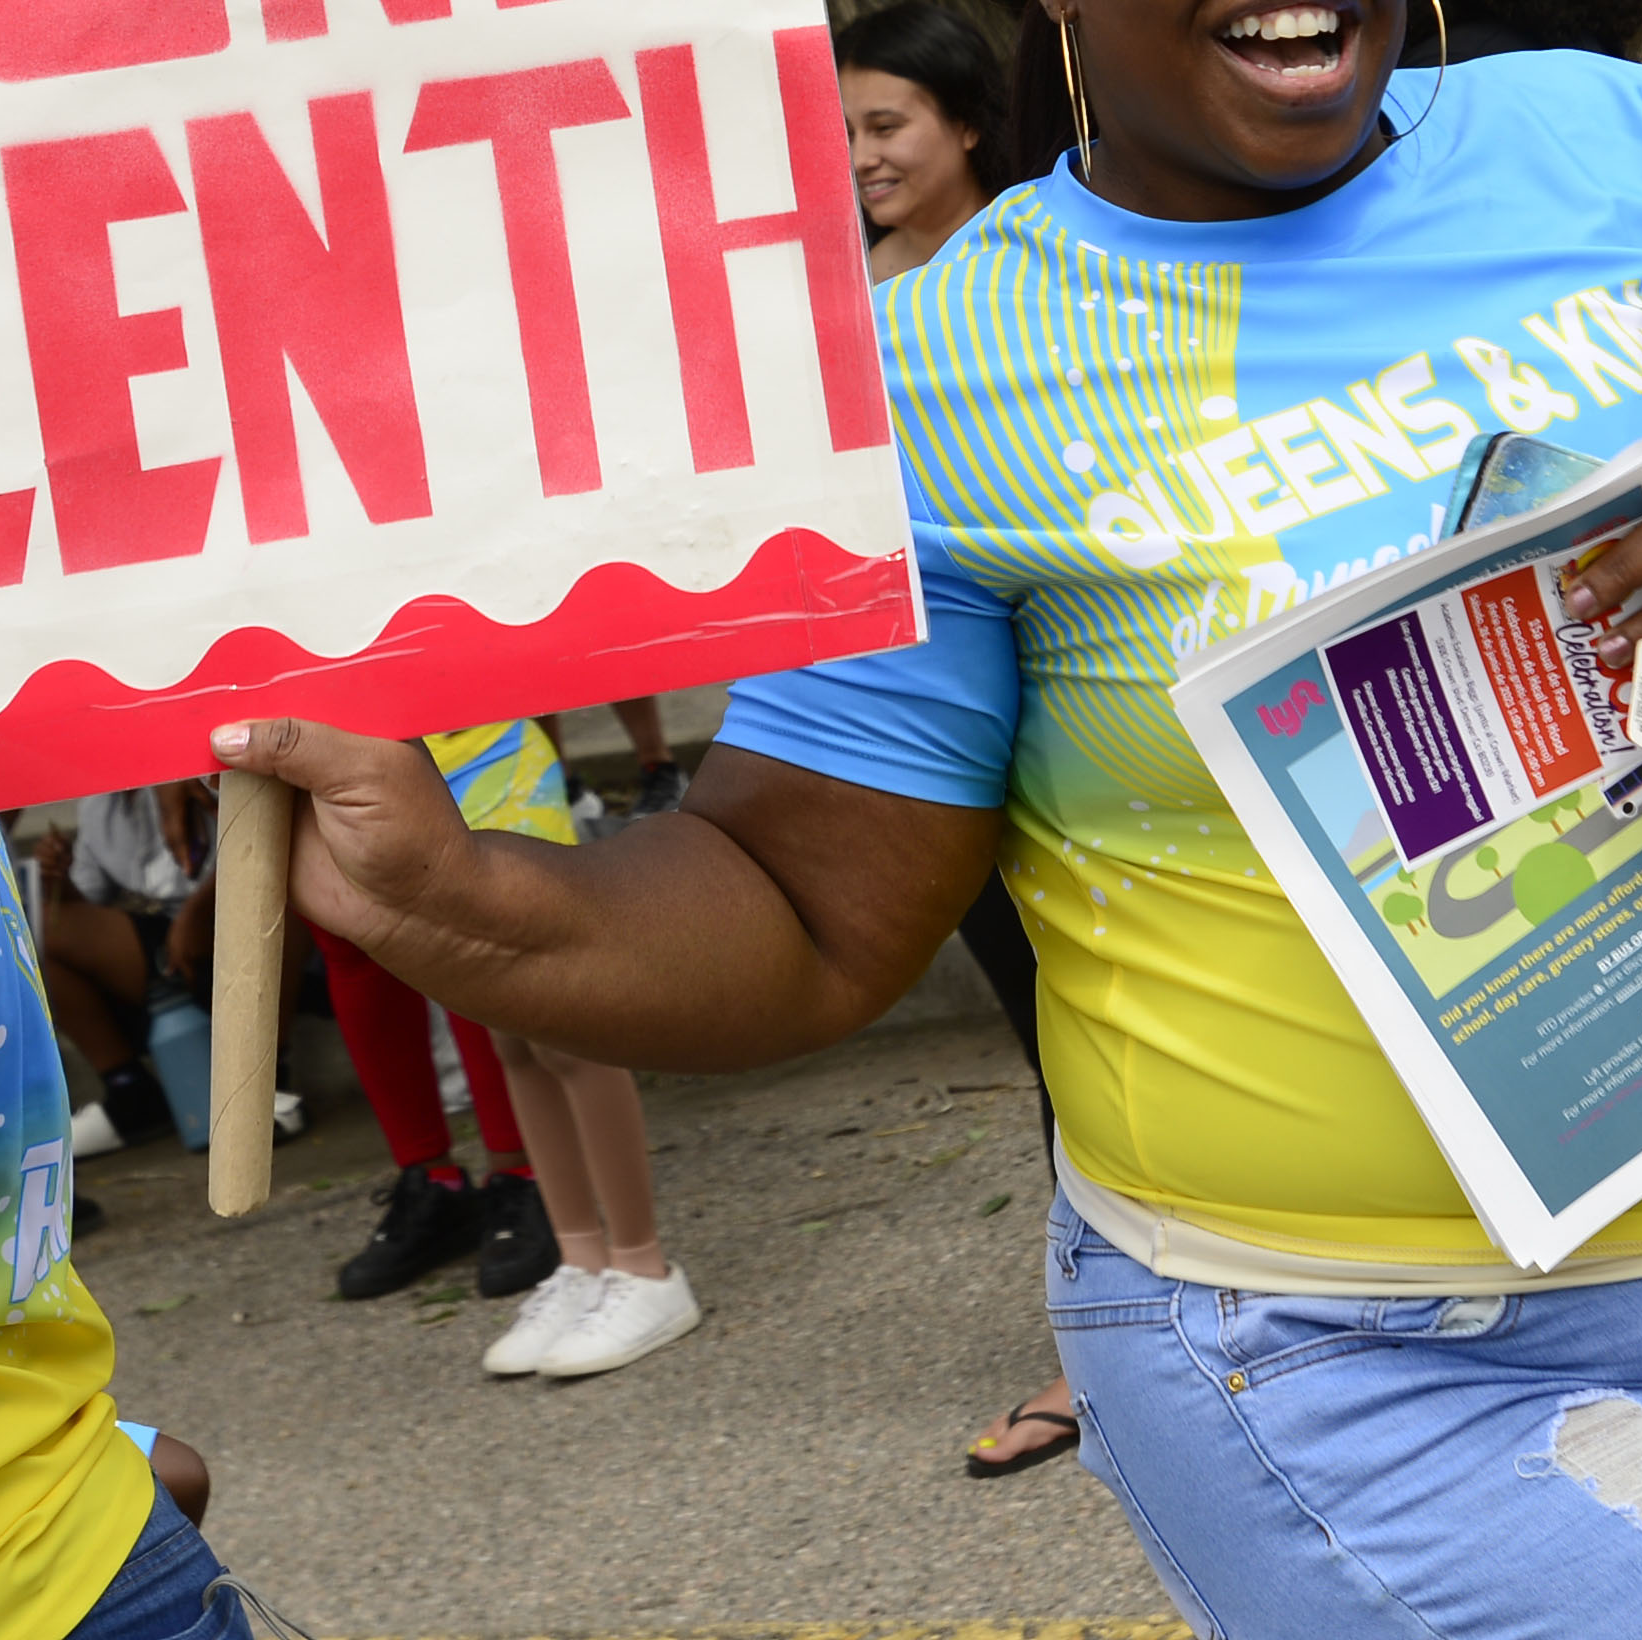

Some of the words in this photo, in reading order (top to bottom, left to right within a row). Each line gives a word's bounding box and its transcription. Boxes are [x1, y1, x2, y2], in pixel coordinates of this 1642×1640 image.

[1088, 352, 1480, 569] QUEENS
[1453, 336, 1579, 434] &
[1494, 625, 1505, 638] de
[1499, 595, 1533, 659] Celebración
[1482, 637, 1495, 650] de
[1494, 671, 1507, 686] de
[1521, 657, 1538, 676] de
[1535, 638, 1556, 672] anual
[1547, 670, 1562, 688] de
[1256, 680, 1326, 737] lyft
[1527, 673, 1547, 703] Heal
[1556, 623, 1636, 756] Celebration!
[1538, 700, 1555, 724] the
[1545, 720, 1568, 757] Hood
[1438, 1004, 1464, 1029] Did
[1461, 989, 1488, 1015] you
[1484, 962, 1521, 996] know
[1518, 937, 1555, 970] there
[1552, 925, 1575, 946] are
[1573, 900, 1608, 930] more
[1449, 1006, 1496, 1047] school,
[1492, 988, 1521, 1017] day
[1516, 967, 1551, 999] care,
[1546, 934, 1597, 978] grocery
[1592, 905, 1635, 943] stores,
[1595, 954, 1614, 974] BY
[1609, 940, 1633, 964] BUS
[1535, 1015, 1558, 1038] RTD
[1554, 988, 1596, 1025] provides
[1520, 1050, 1540, 1070] For
[1537, 1034, 1565, 1059] more
[1599, 1038, 1641, 1075] provides
[1561, 1101, 1581, 1122] For
[1578, 1084, 1607, 1111] more
